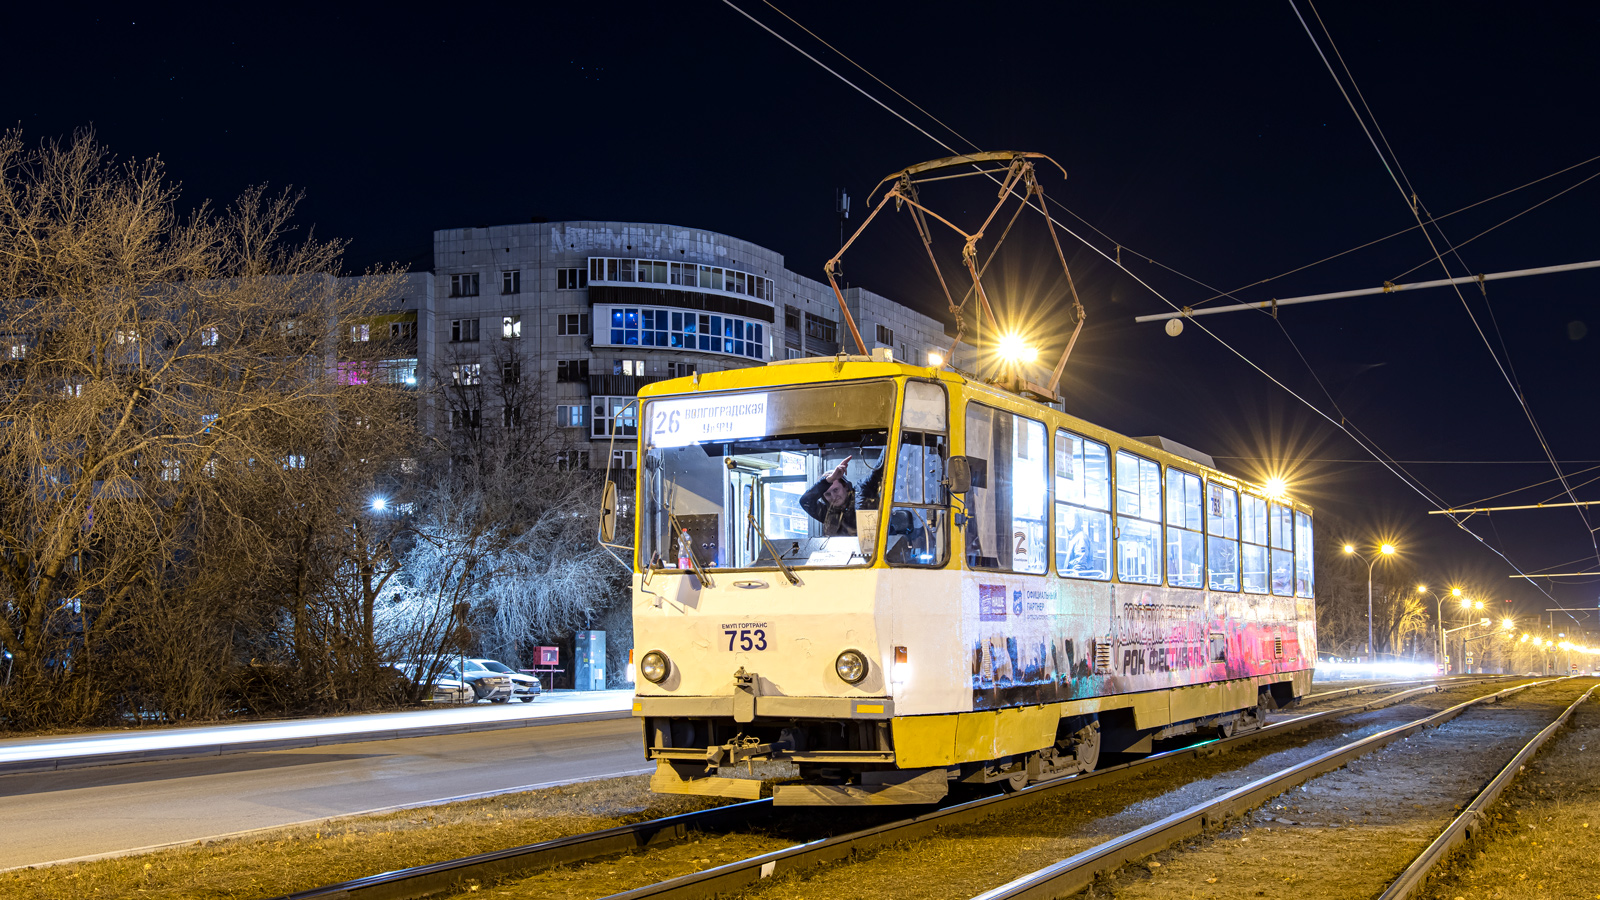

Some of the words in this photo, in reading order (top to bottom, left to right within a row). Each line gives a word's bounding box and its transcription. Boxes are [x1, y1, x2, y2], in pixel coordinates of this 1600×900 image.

[685, 403, 764, 419] ВОЛГОГРАДСКАЯ
[655, 409, 681, 435] 26
[1026, 590, 1057, 599] ОФИЦИАЛЬНЫЙ
[1026, 602, 1045, 612] ПАРТНЕР
[724, 629, 767, 651] 753
[1123, 649, 1146, 676] РОК
[1148, 646, 1204, 673] ФЕСТИВАЛЬ
